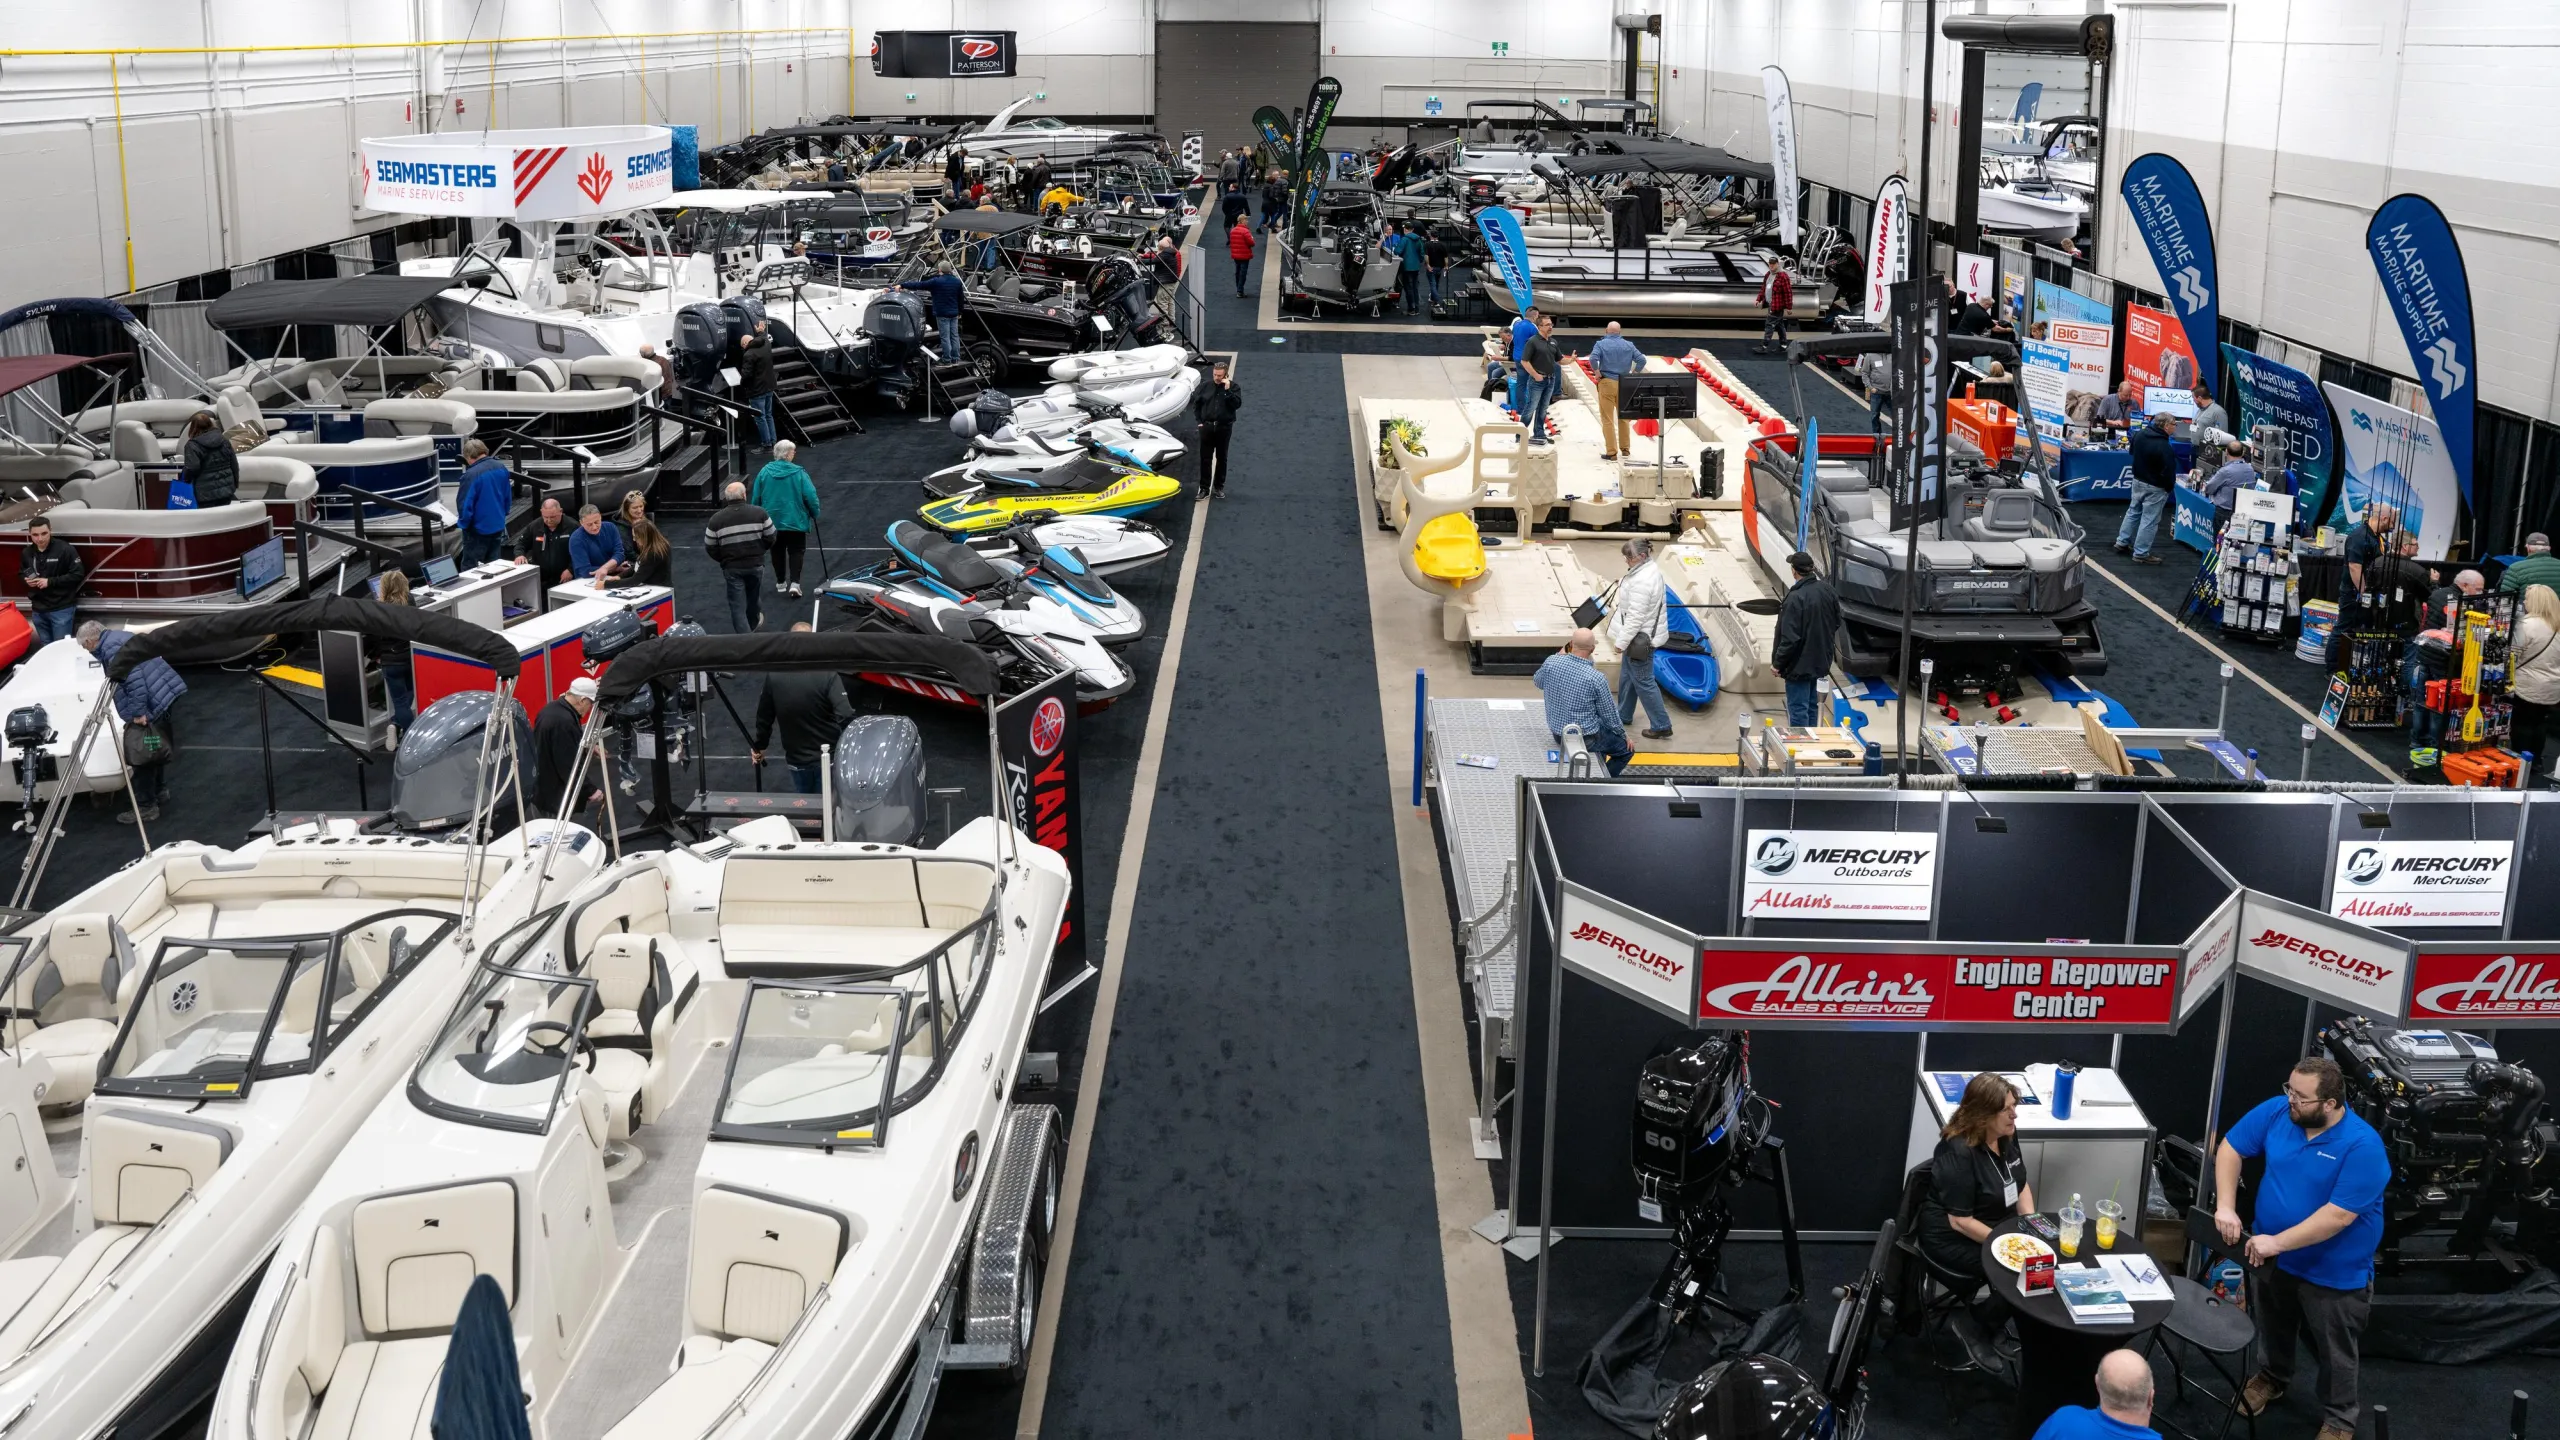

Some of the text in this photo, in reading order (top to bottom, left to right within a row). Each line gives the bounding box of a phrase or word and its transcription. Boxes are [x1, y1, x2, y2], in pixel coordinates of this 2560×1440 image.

[957, 61, 1000, 69] PATTERSON
[1306, 96, 1322, 128] 325-9697
[377, 160, 496, 188] SEAMASTERS
[377, 185, 464, 202] MARINE SERVICES
[627, 180, 655, 192] MARINE
[2129, 183, 2177, 270] MARINE SUPPLY
[2142, 175, 2195, 265] MARITIME
[864, 241, 896, 253] PATTERSON
[1876, 198, 1892, 279] YANMAR
[1895, 193, 1905, 282] KOHLE
[1482, 218, 1528, 292] Wave
[1022, 262, 1046, 271] LEGEND
[2375, 234, 2431, 344] MARINE SUPPLY
[2390, 222, 2449, 337] MARITIME
[25, 304, 57, 318] SYLVAN
[1910, 299, 1938, 312] EXEME
[880, 312, 901, 321] YAMAHA
[2132, 318, 2145, 333] BIG
[682, 323, 700, 331] YAMAHA
[2057, 328, 2079, 340] BIG
[2023, 341, 2068, 361] PEI Boating
[2029, 355, 2060, 371] Festival
[2086, 364, 2104, 373] BIG
[2128, 364, 2163, 387] THINK BIG
[2255, 367, 2299, 393] MARITIME
[2258, 382, 2301, 402] MARINE SUPPLY
[2239, 388, 2264, 411] FUELLED
[2265, 401, 2274, 415] BY
[2275, 405, 2293, 423] THE
[2375, 416, 2432, 446] MARITIME
[2091, 479, 2133, 490] PLAS
[1014, 495, 1085, 503] WAVERUNNER
[1055, 532, 1102, 542] SUPERJET
[606, 632, 625, 644] YAMAHA
[1803, 848, 1931, 865] MERCURY
[2390, 857, 2508, 872] MERCURY
[1833, 866, 1913, 877] Outboards
[2413, 875, 2492, 885] MerCruiser
[1749, 888, 1832, 911] Allain's
[2338, 898, 2413, 918] Allain's
[1569, 921, 1685, 976] MERCURY
[2249, 929, 2393, 981] MERCURY
[1627, 958, 1636, 966] On
[1639, 962, 1651, 972] The
[1653, 967, 1673, 982] Water
[2183, 926, 2232, 994] MERCURY
[1706, 955, 1934, 1004] Allain's
[1954, 957, 2043, 989] Engine
[2050, 957, 2170, 990] Repower
[2308, 959, 2377, 988] #1 On The Water
[1751, 1003, 1931, 1014] SALES & SERVICE
[2012, 990, 2105, 1019] Center
[2455, 1002, 2520, 1011] SALES
[2521, 1002, 2536, 1011] &
[1643, 1099, 1679, 1115] MERCURY
[1645, 1130, 1677, 1151] 60
